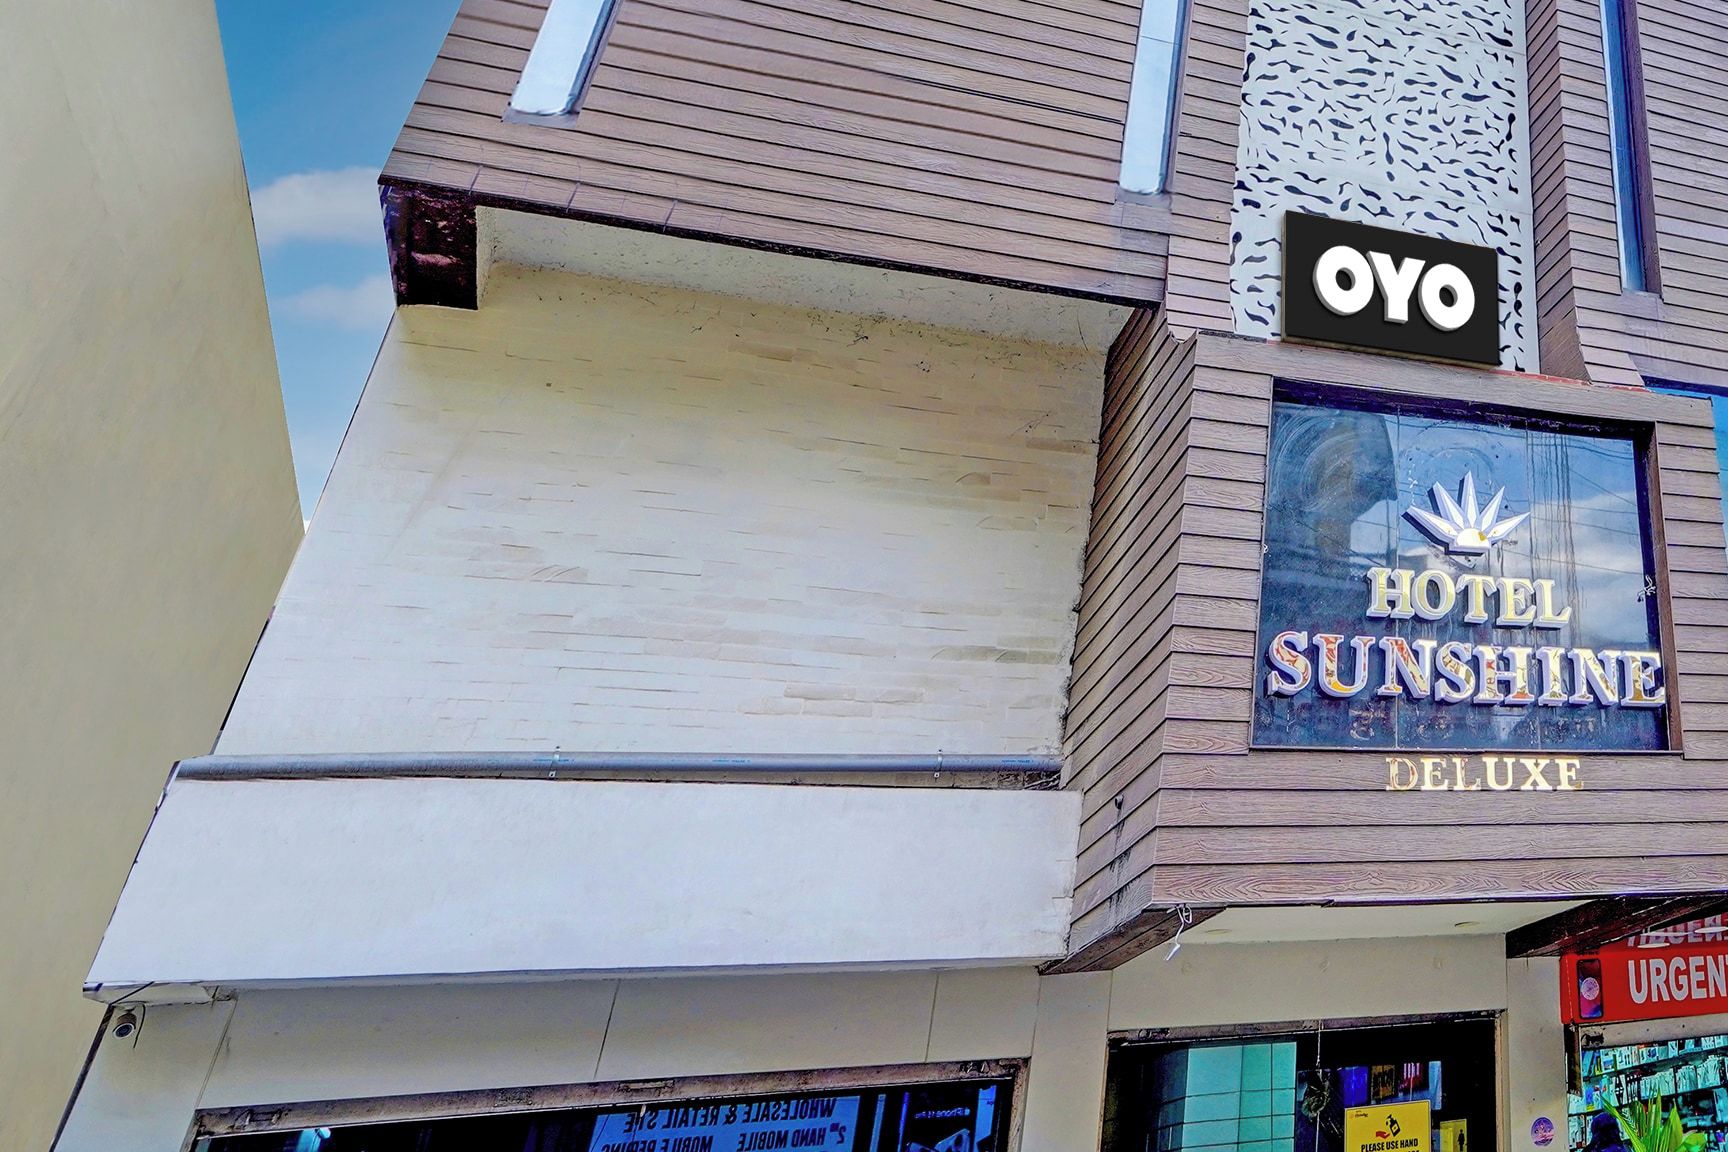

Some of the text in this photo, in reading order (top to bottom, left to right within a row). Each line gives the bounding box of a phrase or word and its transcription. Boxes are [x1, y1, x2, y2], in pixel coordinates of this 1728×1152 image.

[1312, 244, 1475, 332] OYO
[1366, 566, 1573, 629] HOTEL
[1267, 630, 1666, 708] SUNSHINE
[1385, 756, 1584, 791] DELUXE
[1361, 1138, 1419, 1152] PLEASE USE HAND
